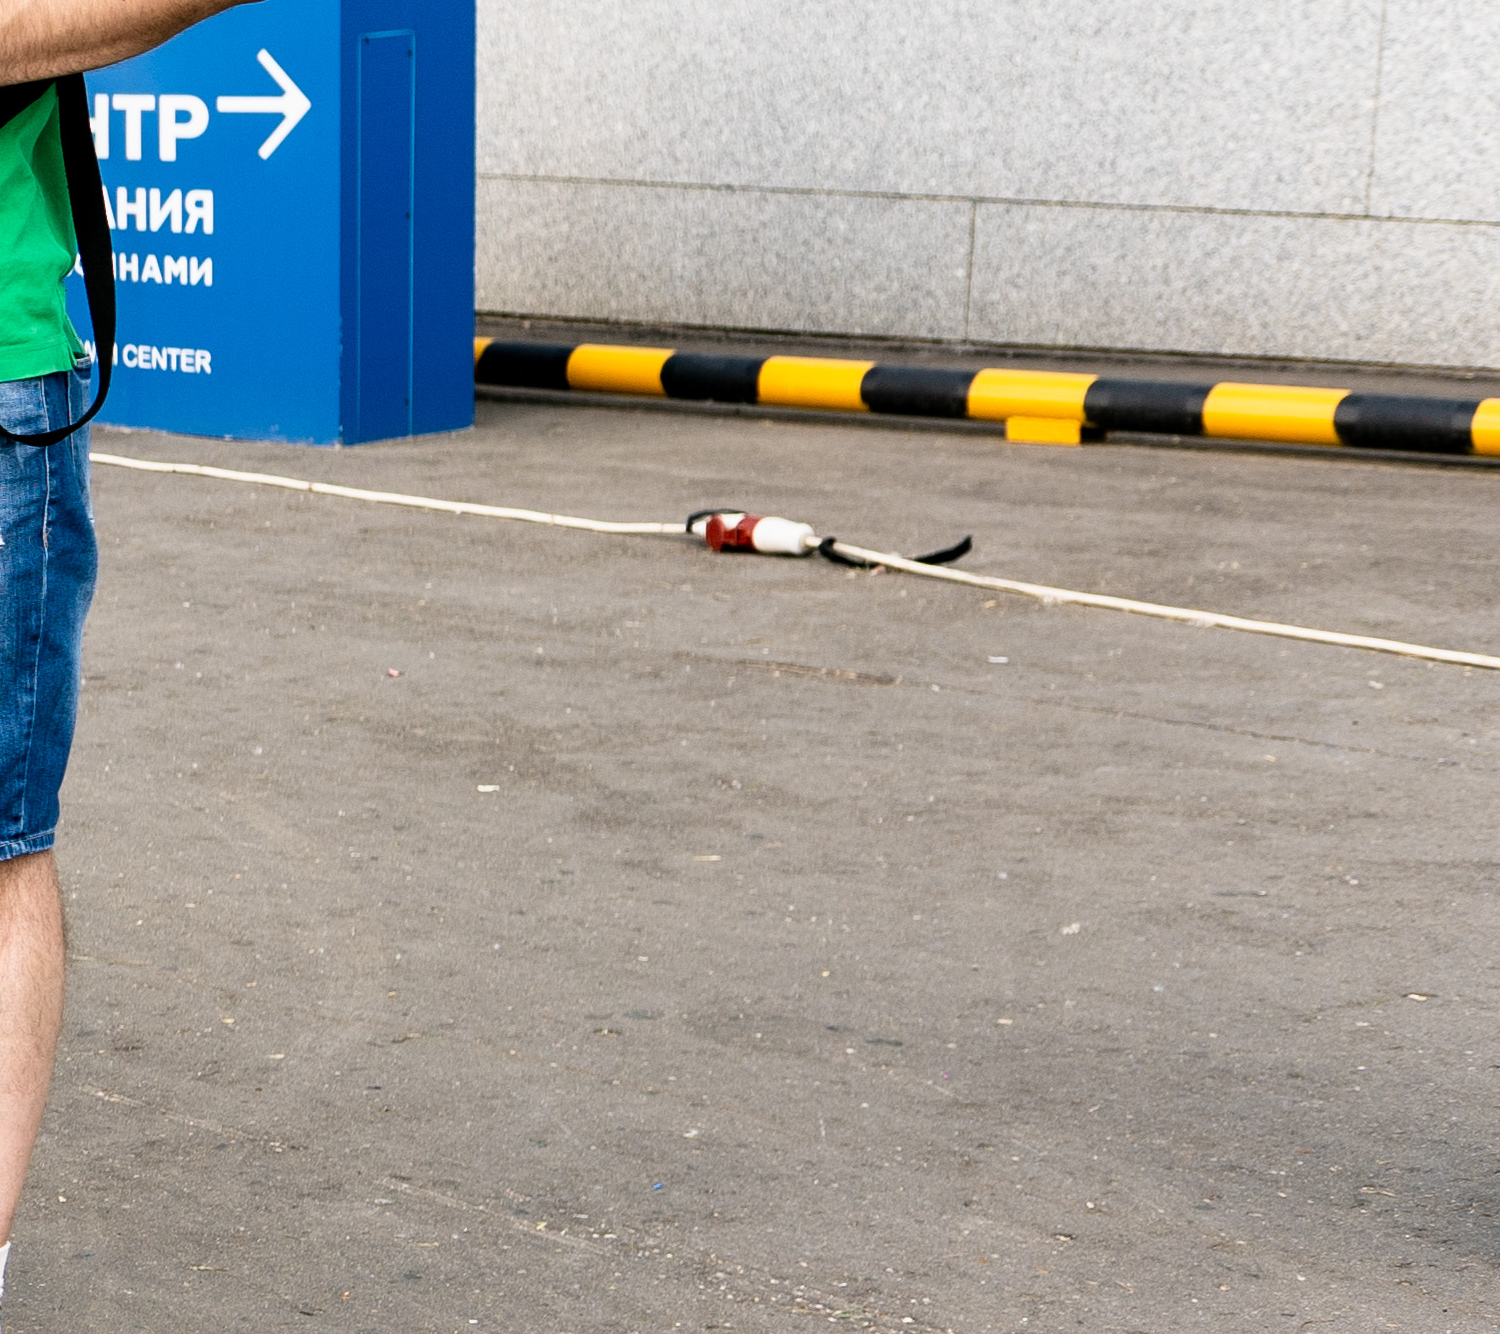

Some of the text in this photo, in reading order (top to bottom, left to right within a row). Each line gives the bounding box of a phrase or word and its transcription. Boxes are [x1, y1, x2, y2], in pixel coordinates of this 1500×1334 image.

[88, 93, 211, 163] НТР
[113, 251, 214, 287] НАМИ
[122, 343, 213, 375] CENTER
